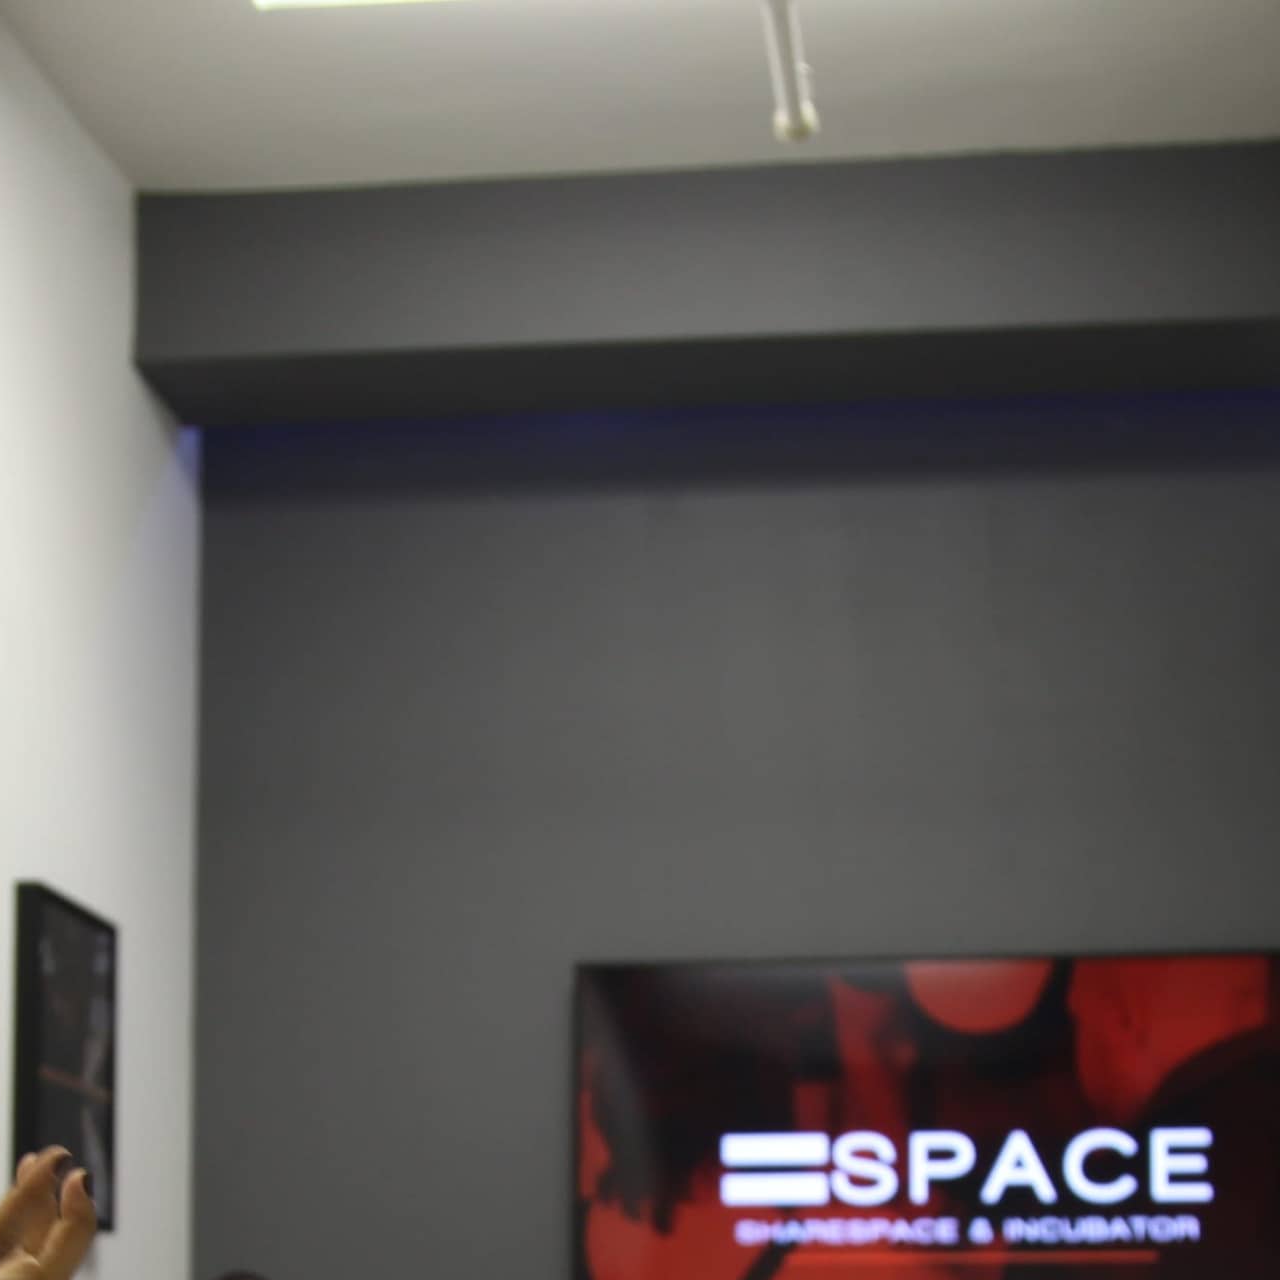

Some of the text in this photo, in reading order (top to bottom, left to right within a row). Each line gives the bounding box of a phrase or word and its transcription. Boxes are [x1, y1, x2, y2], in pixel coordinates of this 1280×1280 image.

[733, 1213, 1201, 1245] SHARESPACE & INCUBATOR
